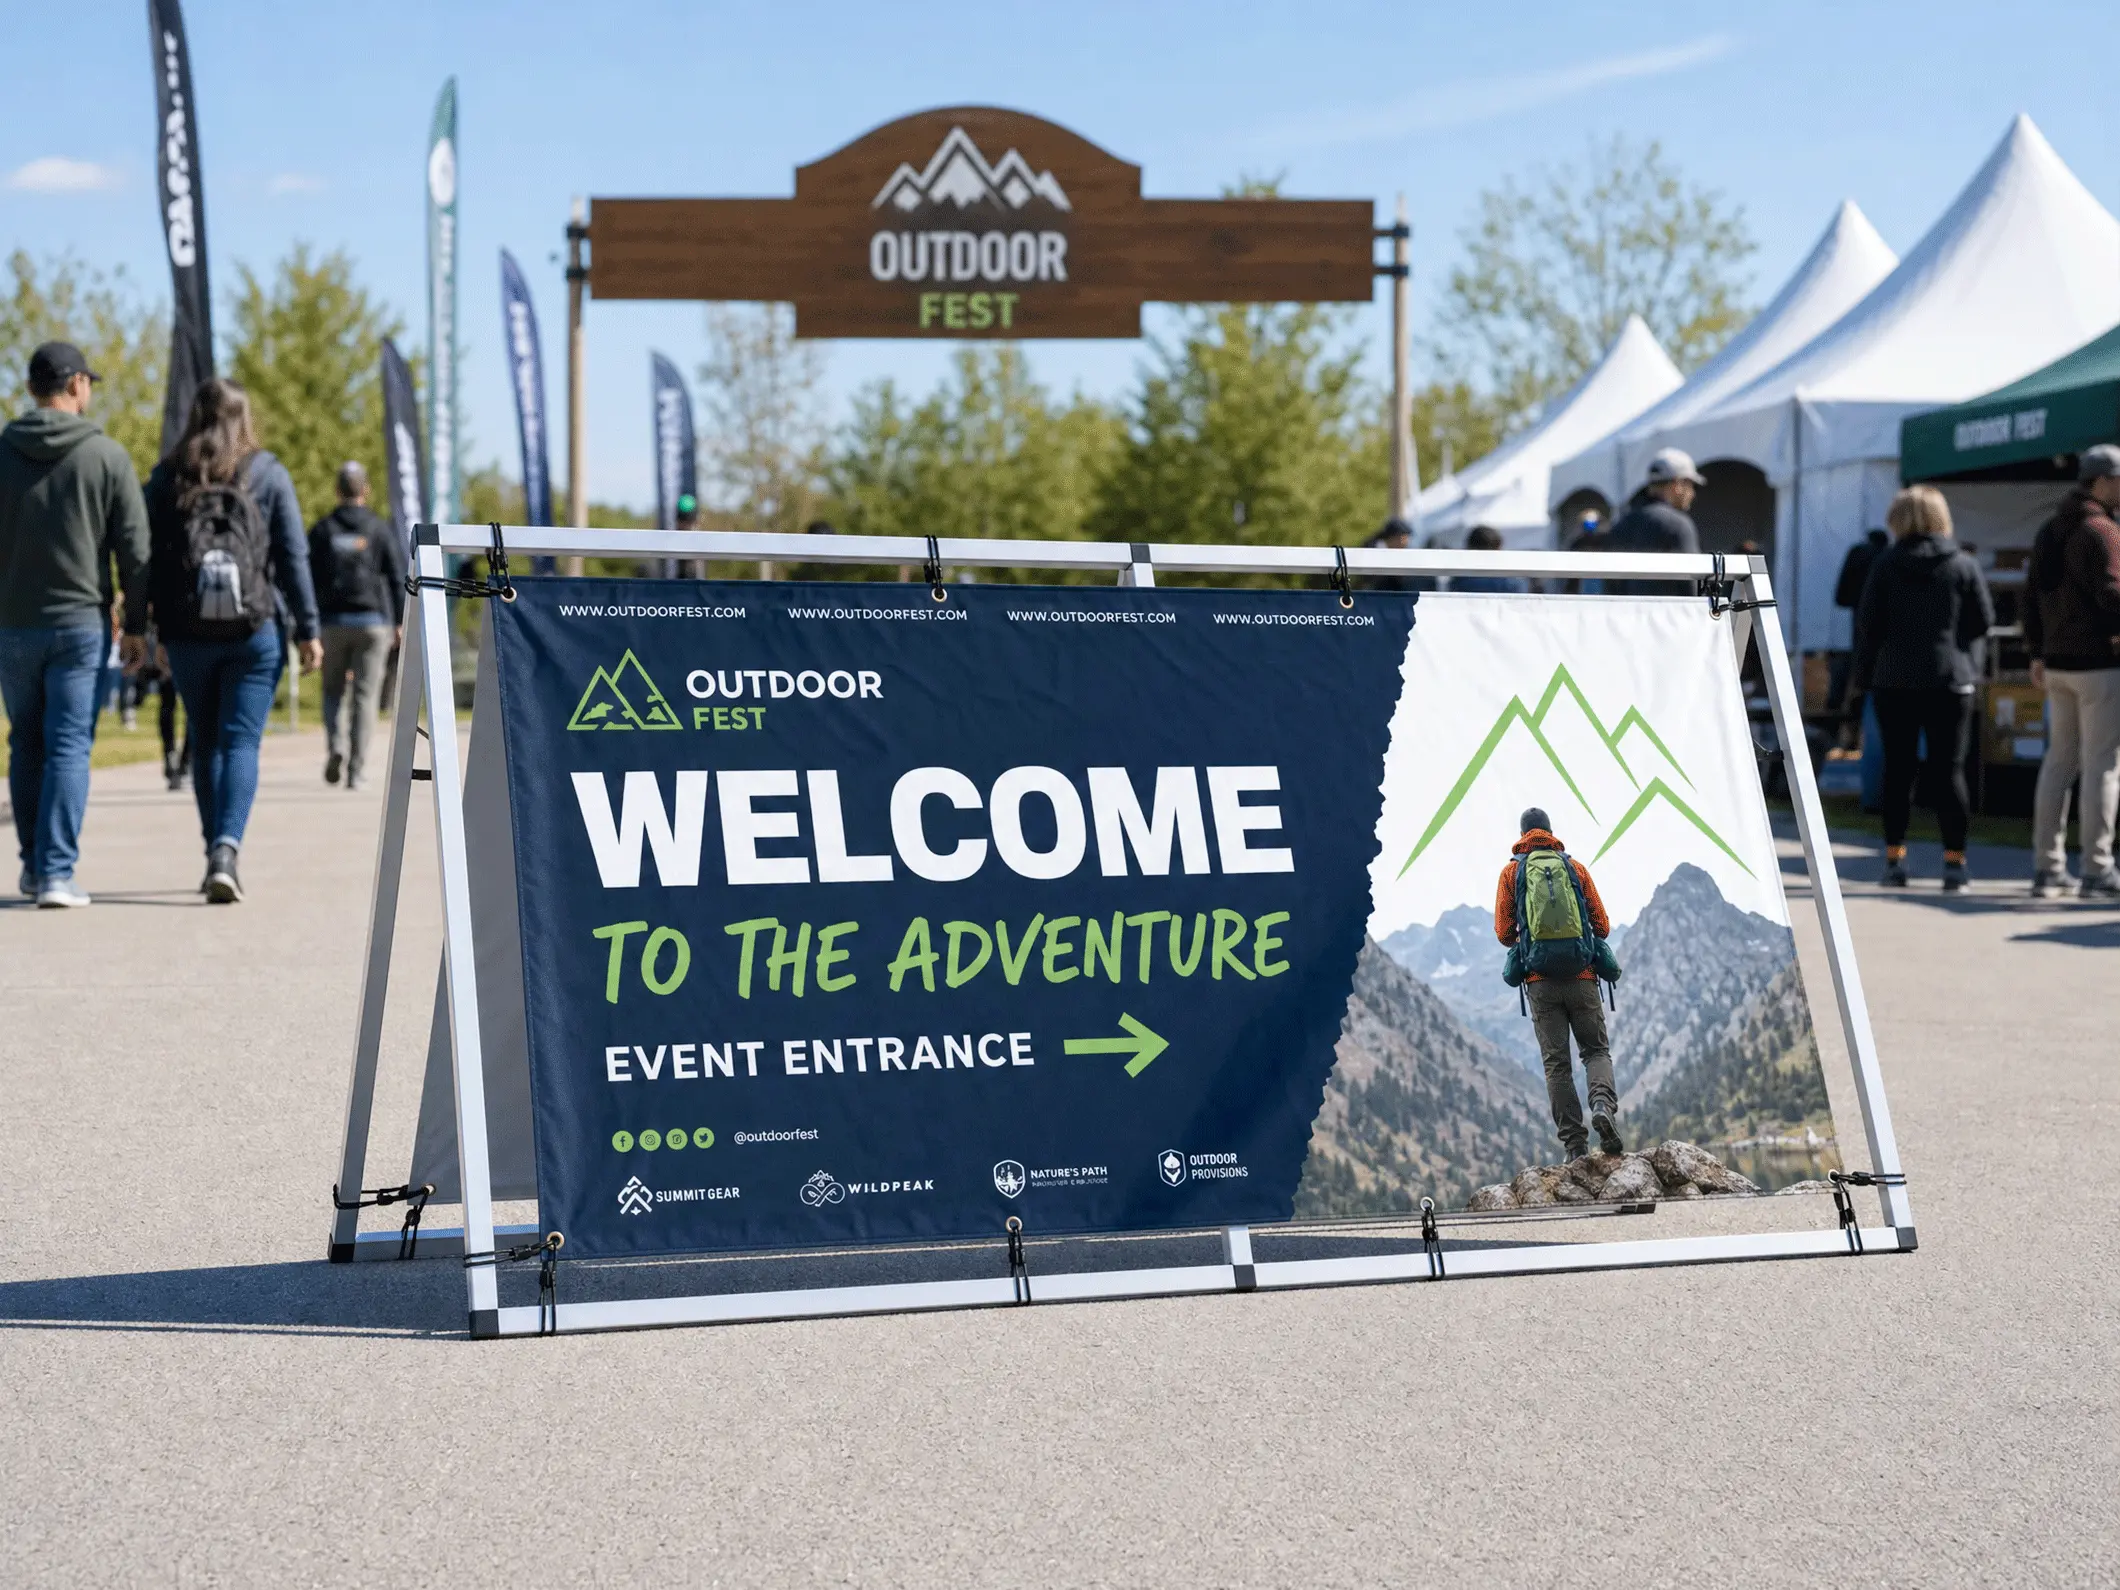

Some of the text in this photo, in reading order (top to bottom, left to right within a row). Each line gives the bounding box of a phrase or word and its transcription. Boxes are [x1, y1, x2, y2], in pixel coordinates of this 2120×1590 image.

[871, 231, 1068, 281] OUTDOOR
[919, 292, 1018, 328] FEST
[558, 605, 1375, 627] WWW.OUTDOORFEST.COM WWW.OUTDOORFEST.COM WWW.OUTDOORFEST.COM WWW.OUTDOORFEST.COM
[686, 669, 884, 699] OUTDOOR
[693, 706, 766, 731] FEST
[571, 765, 1295, 888] WELCOME
[592, 908, 1291, 1005] TO THE ADVENTURE
[605, 1032, 1035, 1082] EVENT ENTRANCE
[733, 1128, 819, 1145] @outdoorfest
[1189, 1152, 1238, 1166] OUTDOOR
[1030, 1165, 1108, 1179] NATURE'S PATH
[1191, 1166, 1249, 1180] PROVISIONS
[847, 1179, 934, 1195] WILDPEAK
